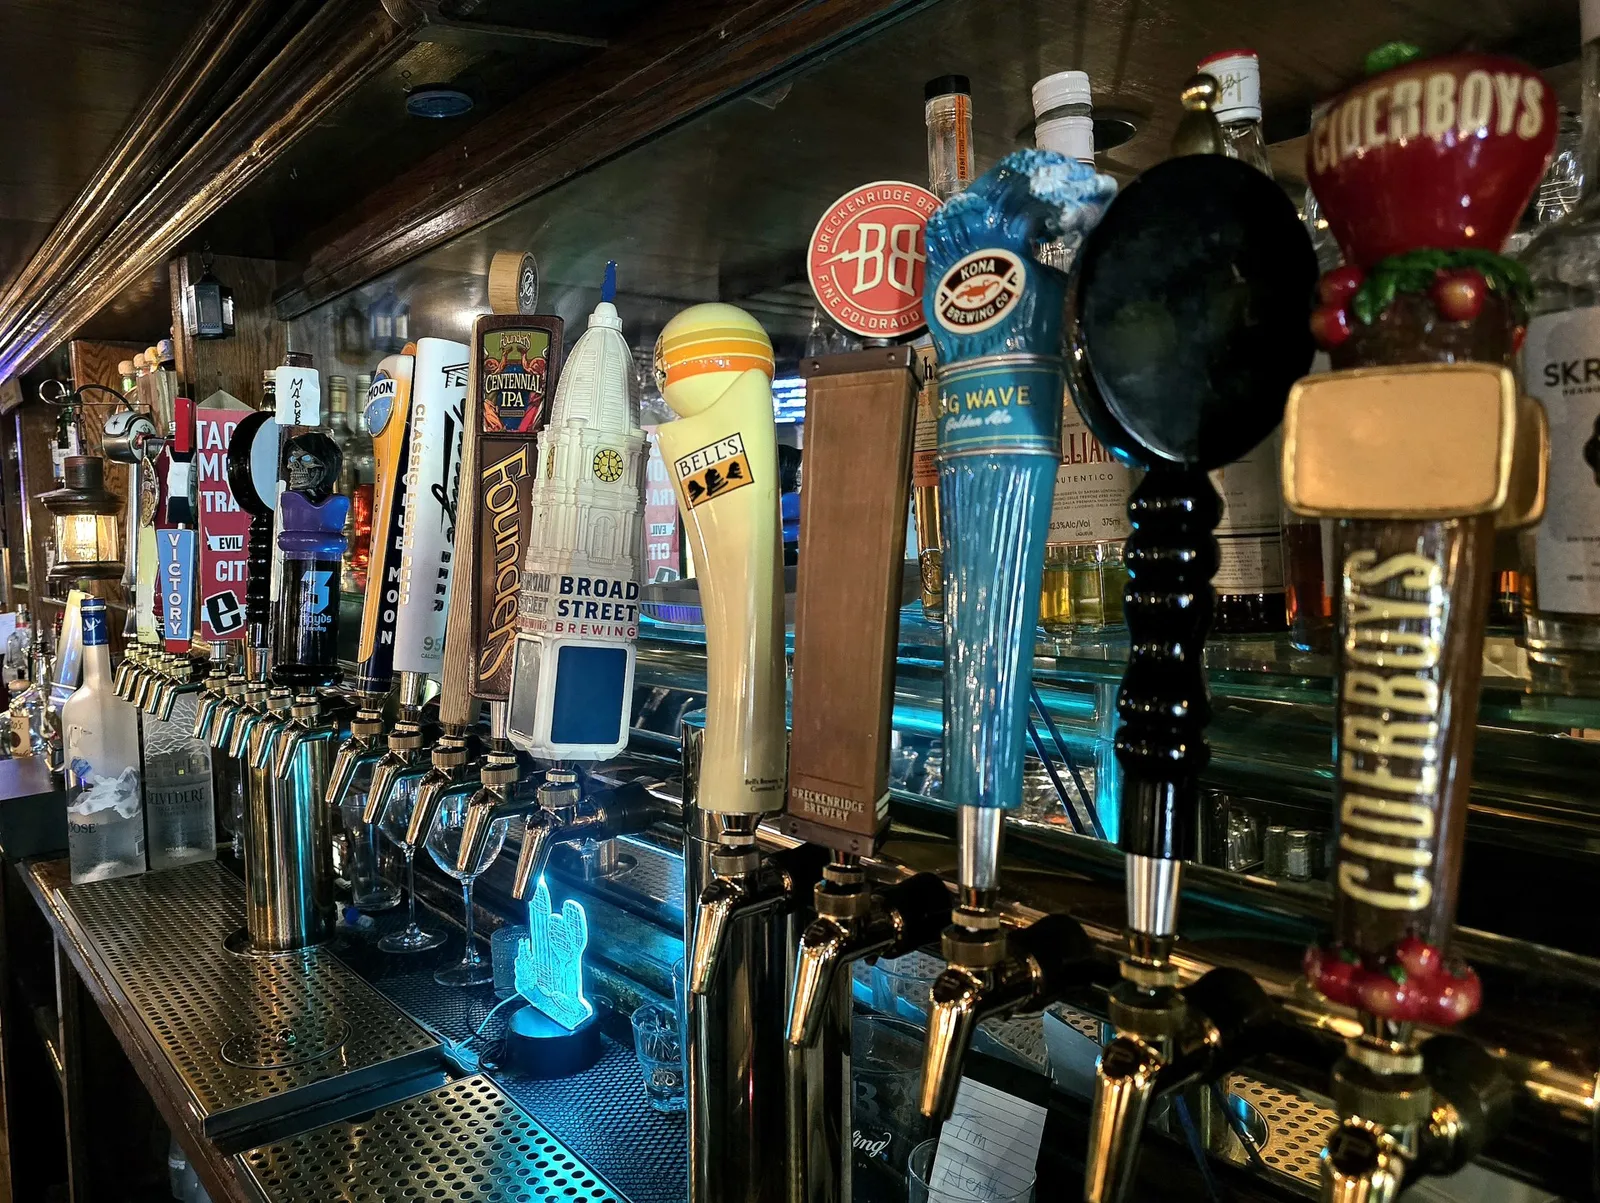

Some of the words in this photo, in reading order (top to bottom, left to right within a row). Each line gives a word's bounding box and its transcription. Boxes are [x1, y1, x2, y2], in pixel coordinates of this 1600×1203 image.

[1313, 70, 1544, 174] CIDERBOYS
[818, 189, 912, 253] BRECKENRIDGE
[960, 258, 996, 282] KONA
[818, 274, 842, 308] FINE
[840, 306, 921, 329] COLORADO
[946, 303, 995, 325] BREWING
[368, 381, 393, 402] MOON
[485, 373, 542, 394] CENTENNIAL
[501, 391, 525, 407] IPA
[965, 385, 1032, 411] WAVE
[409, 403, 425, 486] CLASSIC
[679, 438, 740, 479] BELL'S
[219, 537, 242, 549] EVIL
[168, 533, 182, 636] VICTORY
[559, 576, 639, 600] BROAD
[380, 567, 400, 644] MOON
[557, 600, 638, 622] STREET
[555, 622, 636, 637] BREWING
[423, 636, 443, 651] 95
[1338, 549, 1443, 911] CIDERBOYS
[791, 787, 865, 813] BRECKENRIDGE
[803, 802, 850, 822] BREWERY
